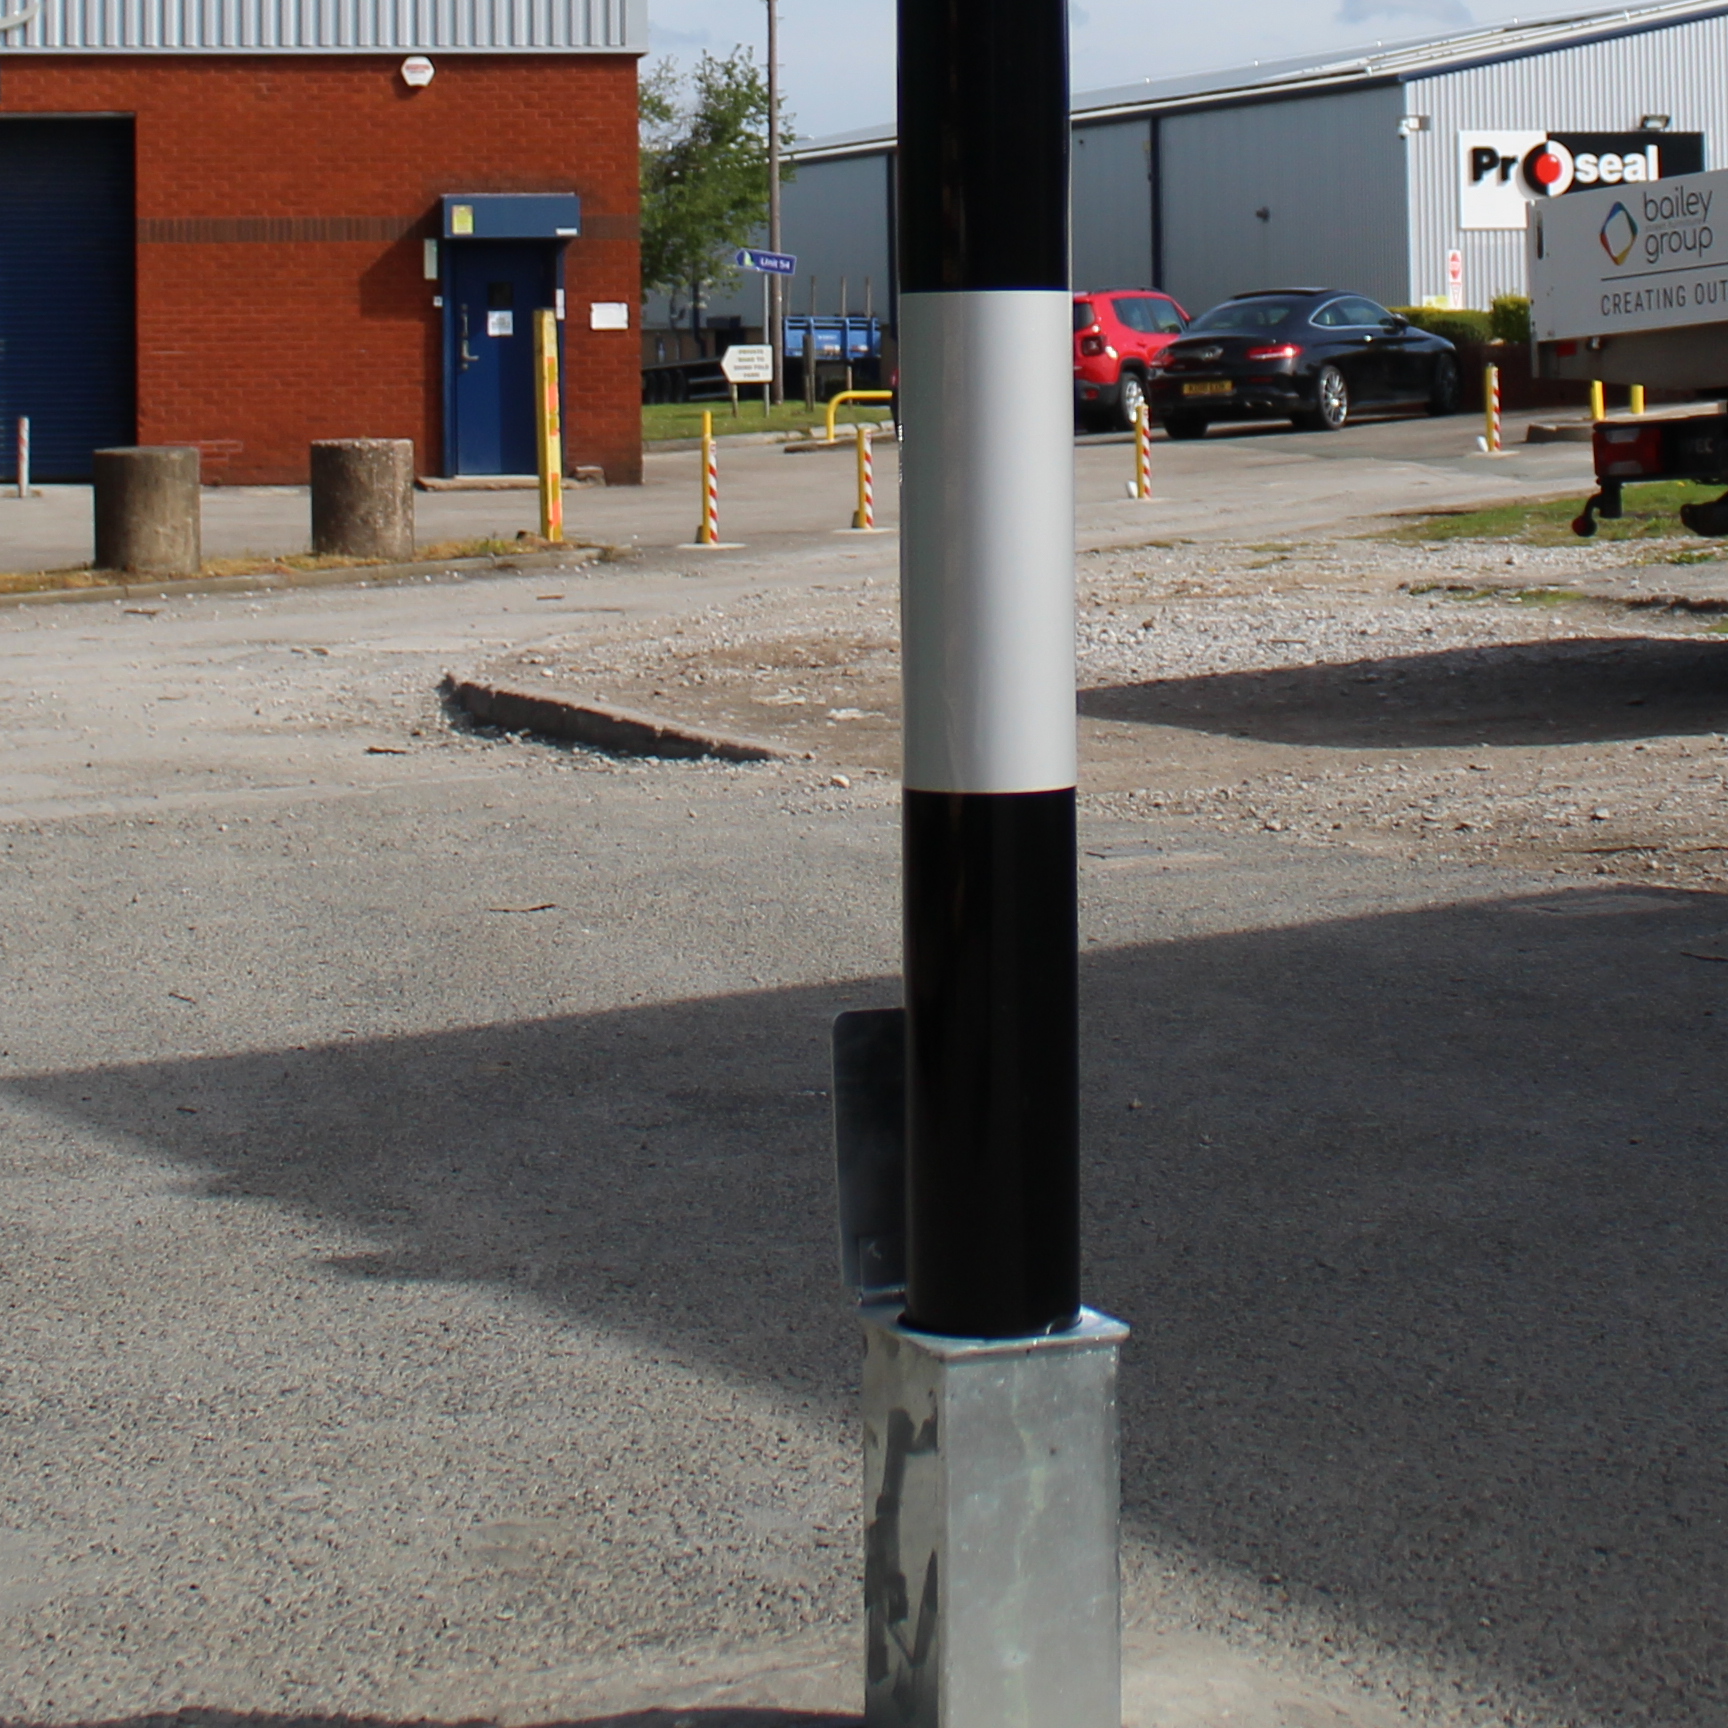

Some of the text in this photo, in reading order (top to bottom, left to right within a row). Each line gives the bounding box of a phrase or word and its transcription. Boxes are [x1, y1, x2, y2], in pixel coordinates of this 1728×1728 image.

[1642, 184, 1713, 223] bailey
[1644, 226, 1713, 264] group
[1600, 284, 1687, 316] CREATING
